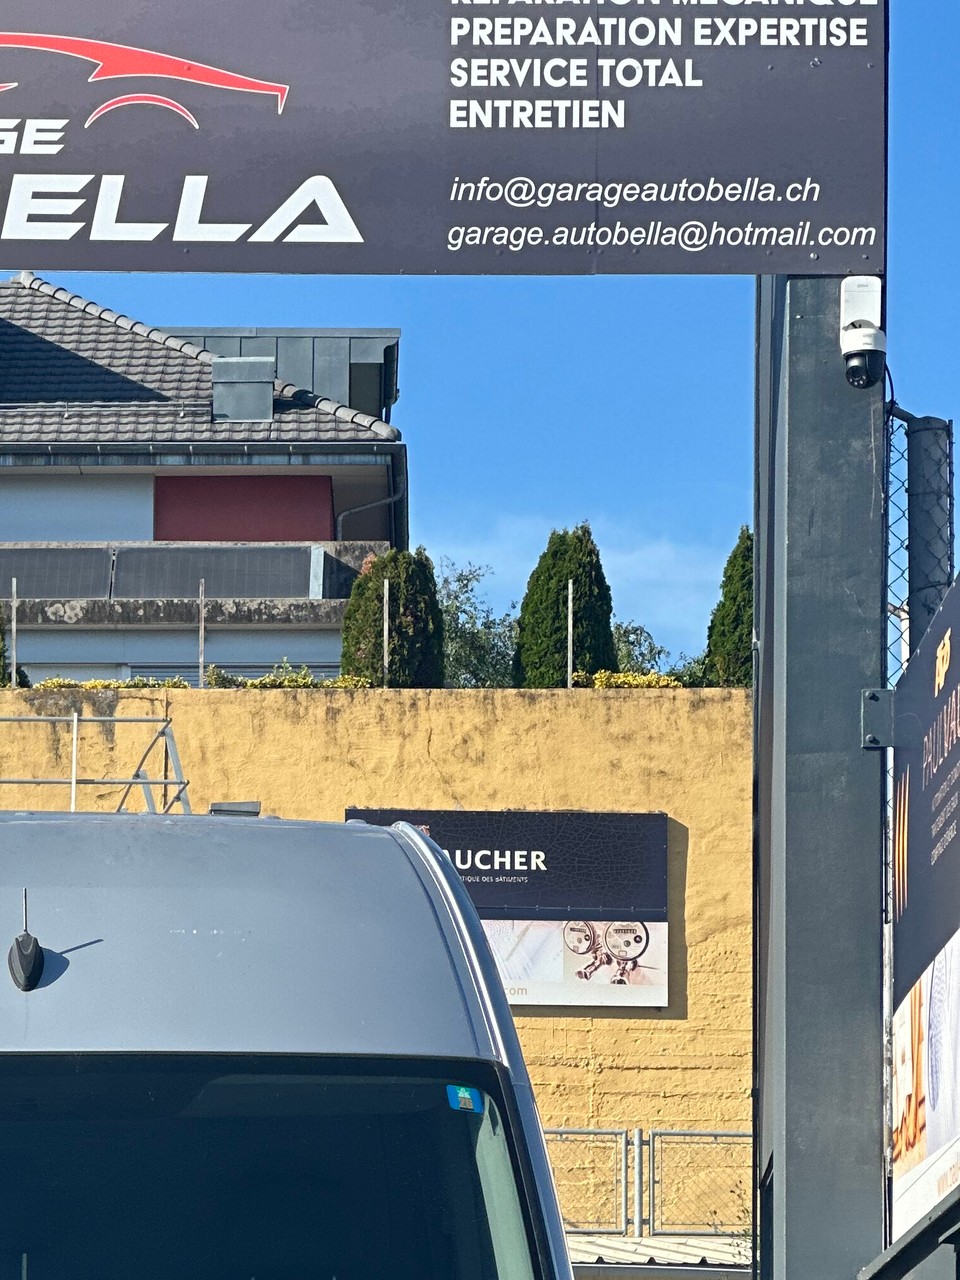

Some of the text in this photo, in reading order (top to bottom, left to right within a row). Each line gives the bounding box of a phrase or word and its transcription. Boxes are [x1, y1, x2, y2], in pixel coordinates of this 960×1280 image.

[451, 17, 868, 47] PREPARATION EXPERTISE
[451, 58, 703, 88] SERVICE TOTAL
[450, 100, 625, 129] ENTRETIEN
[450, 177, 820, 208] info@garageautobella.ch
[447, 220, 877, 252] garage.autobella@hotmail.com
[460, 875, 480, 883] TIQUE
[505, 987, 528, 996] com
